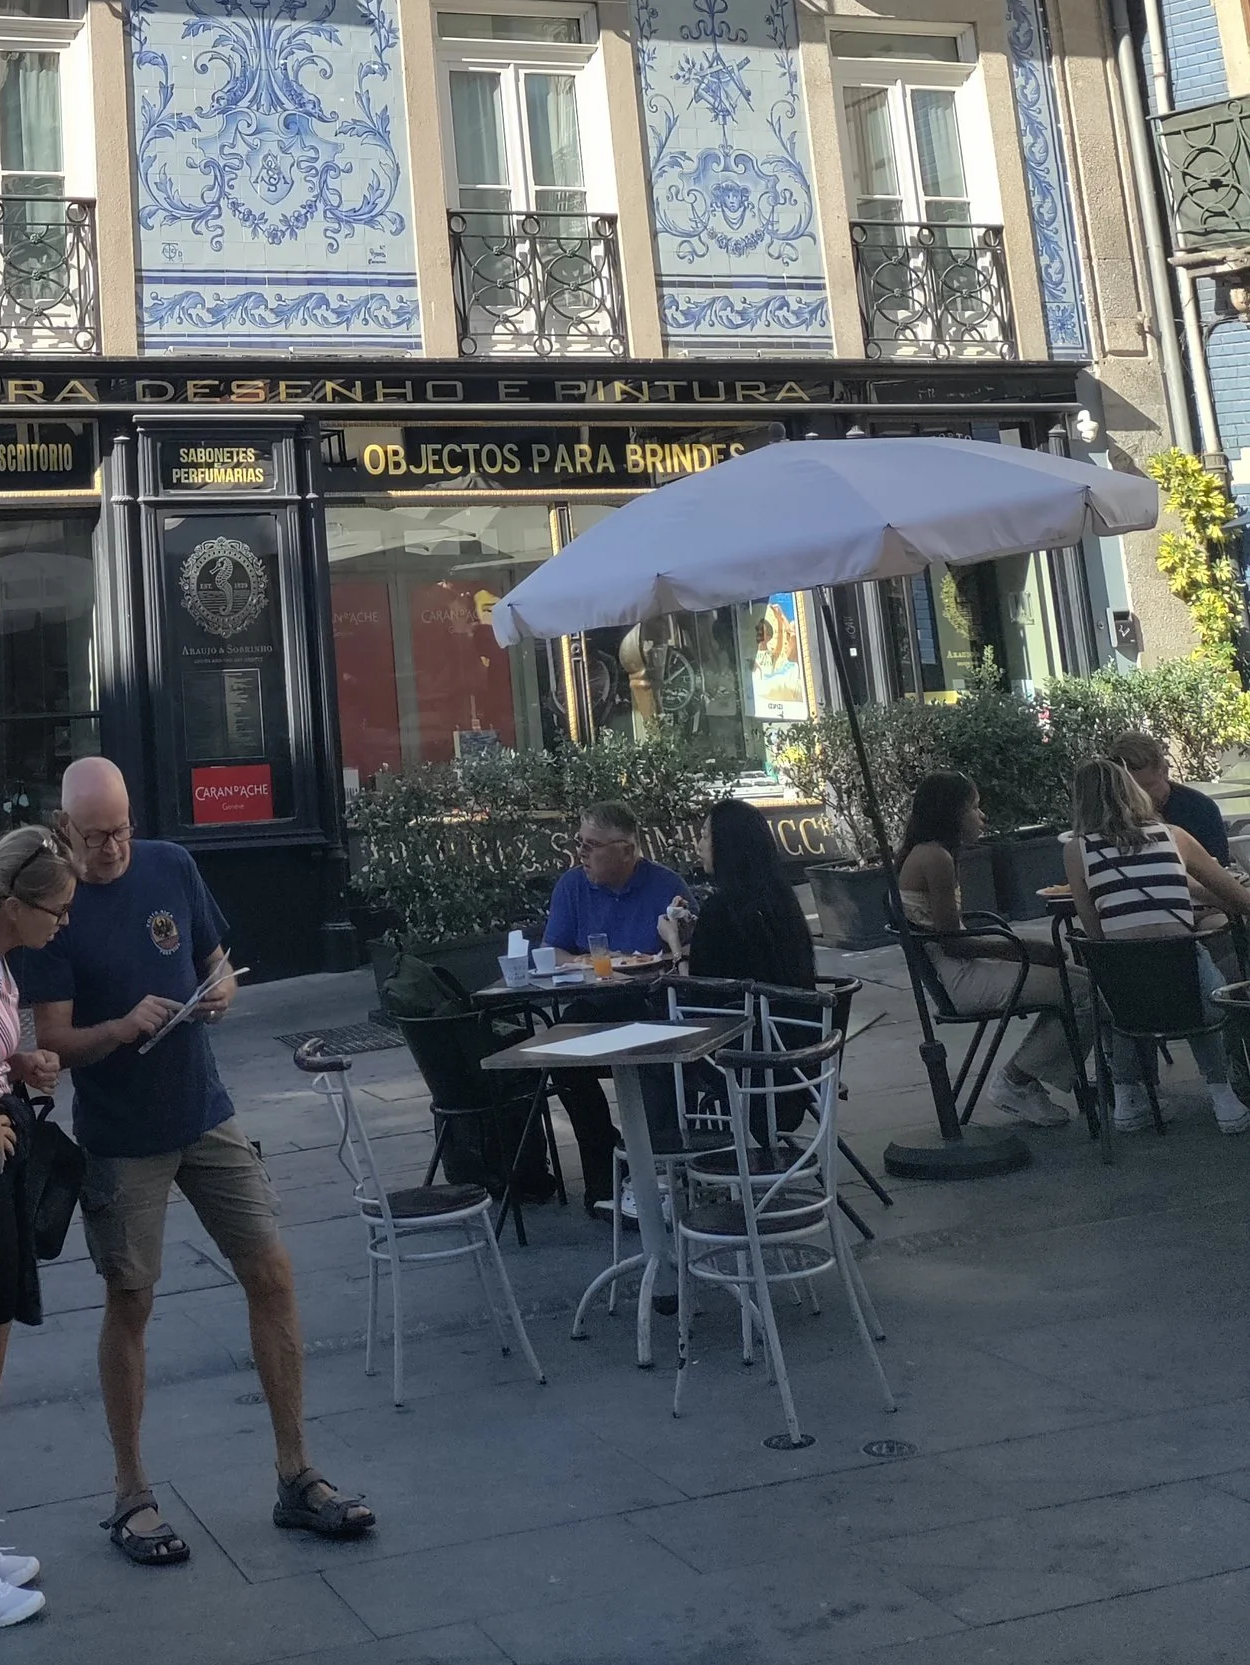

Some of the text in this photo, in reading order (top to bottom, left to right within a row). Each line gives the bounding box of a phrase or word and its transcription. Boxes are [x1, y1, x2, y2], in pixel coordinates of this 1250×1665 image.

[136, 379, 463, 404] DESENHO
[497, 380, 530, 402] E
[555, 379, 811, 403] PINTURA
[179, 447, 256, 464] SABONETES
[363, 443, 521, 475] OBJECTOS
[533, 442, 616, 474] PARA
[172, 467, 265, 485] PERFUMARIAS
[182, 645, 216, 656] ARAUJO
[227, 644, 273, 654] SOBRINHO
